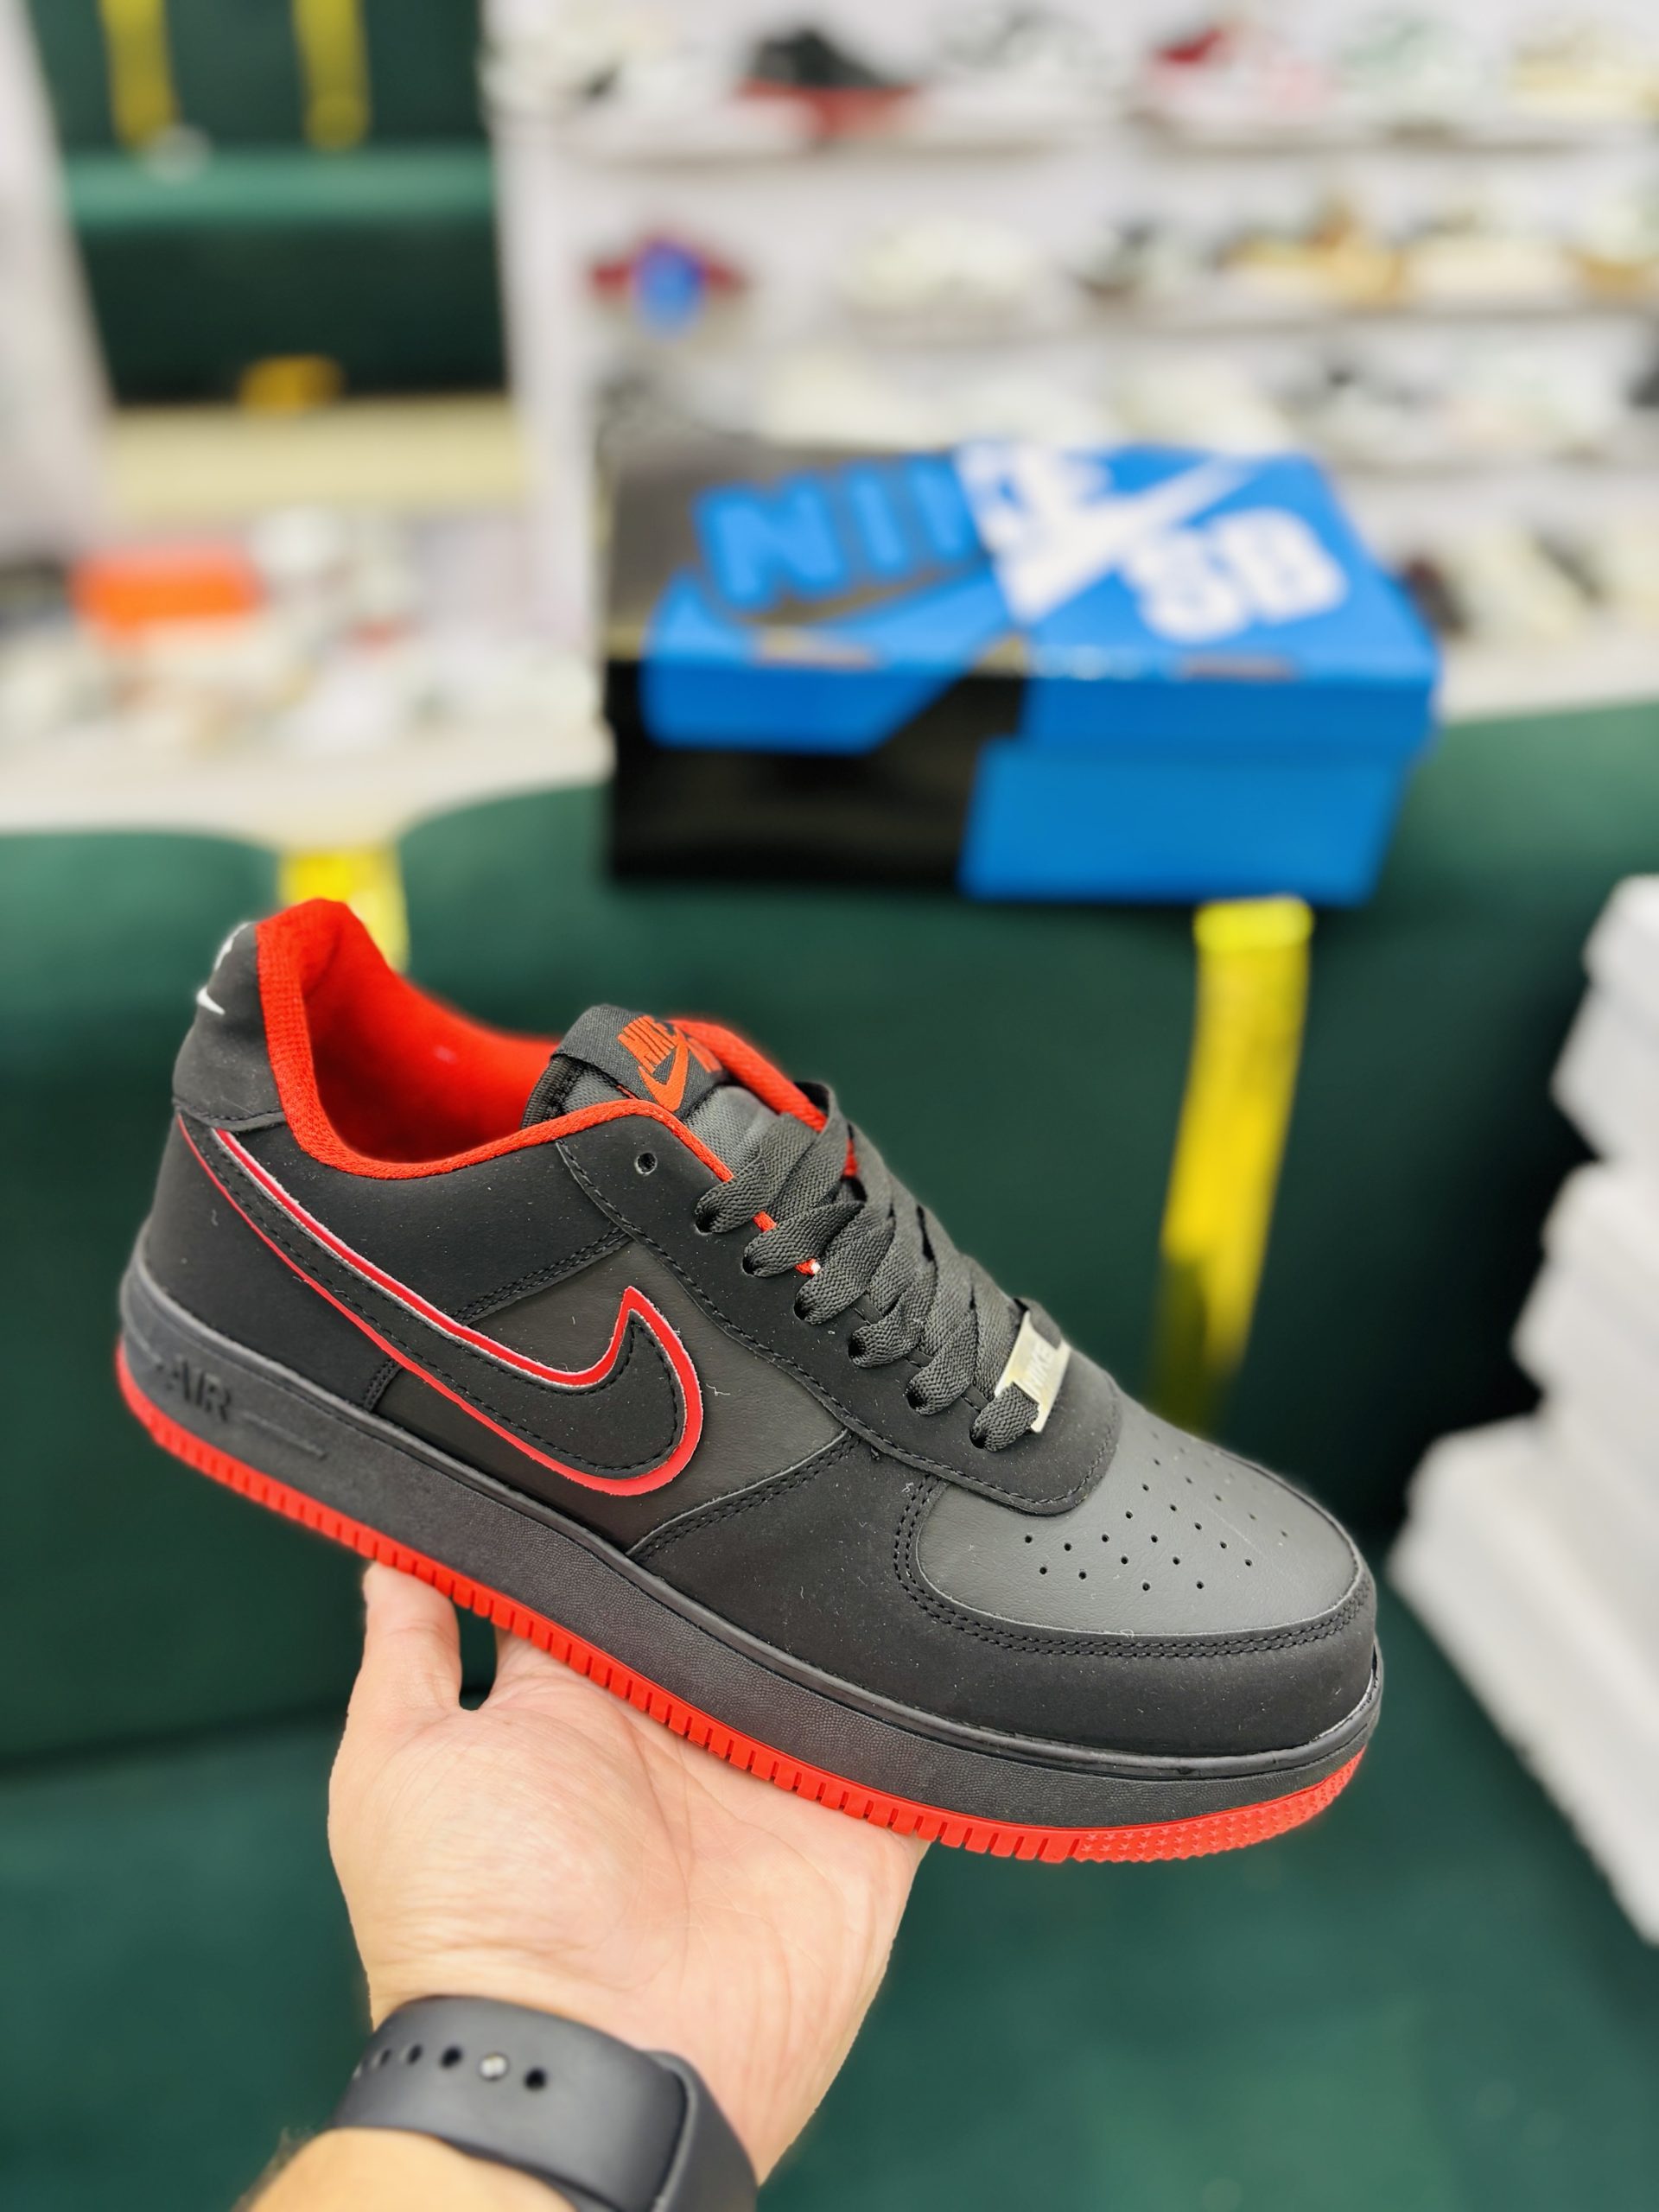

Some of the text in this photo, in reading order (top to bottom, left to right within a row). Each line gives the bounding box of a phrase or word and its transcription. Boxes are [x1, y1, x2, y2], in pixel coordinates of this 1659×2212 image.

[1127, 506, 1348, 644] SB
[617, 1014, 677, 1074] NIKE
[162, 1352, 232, 1423] AIR
